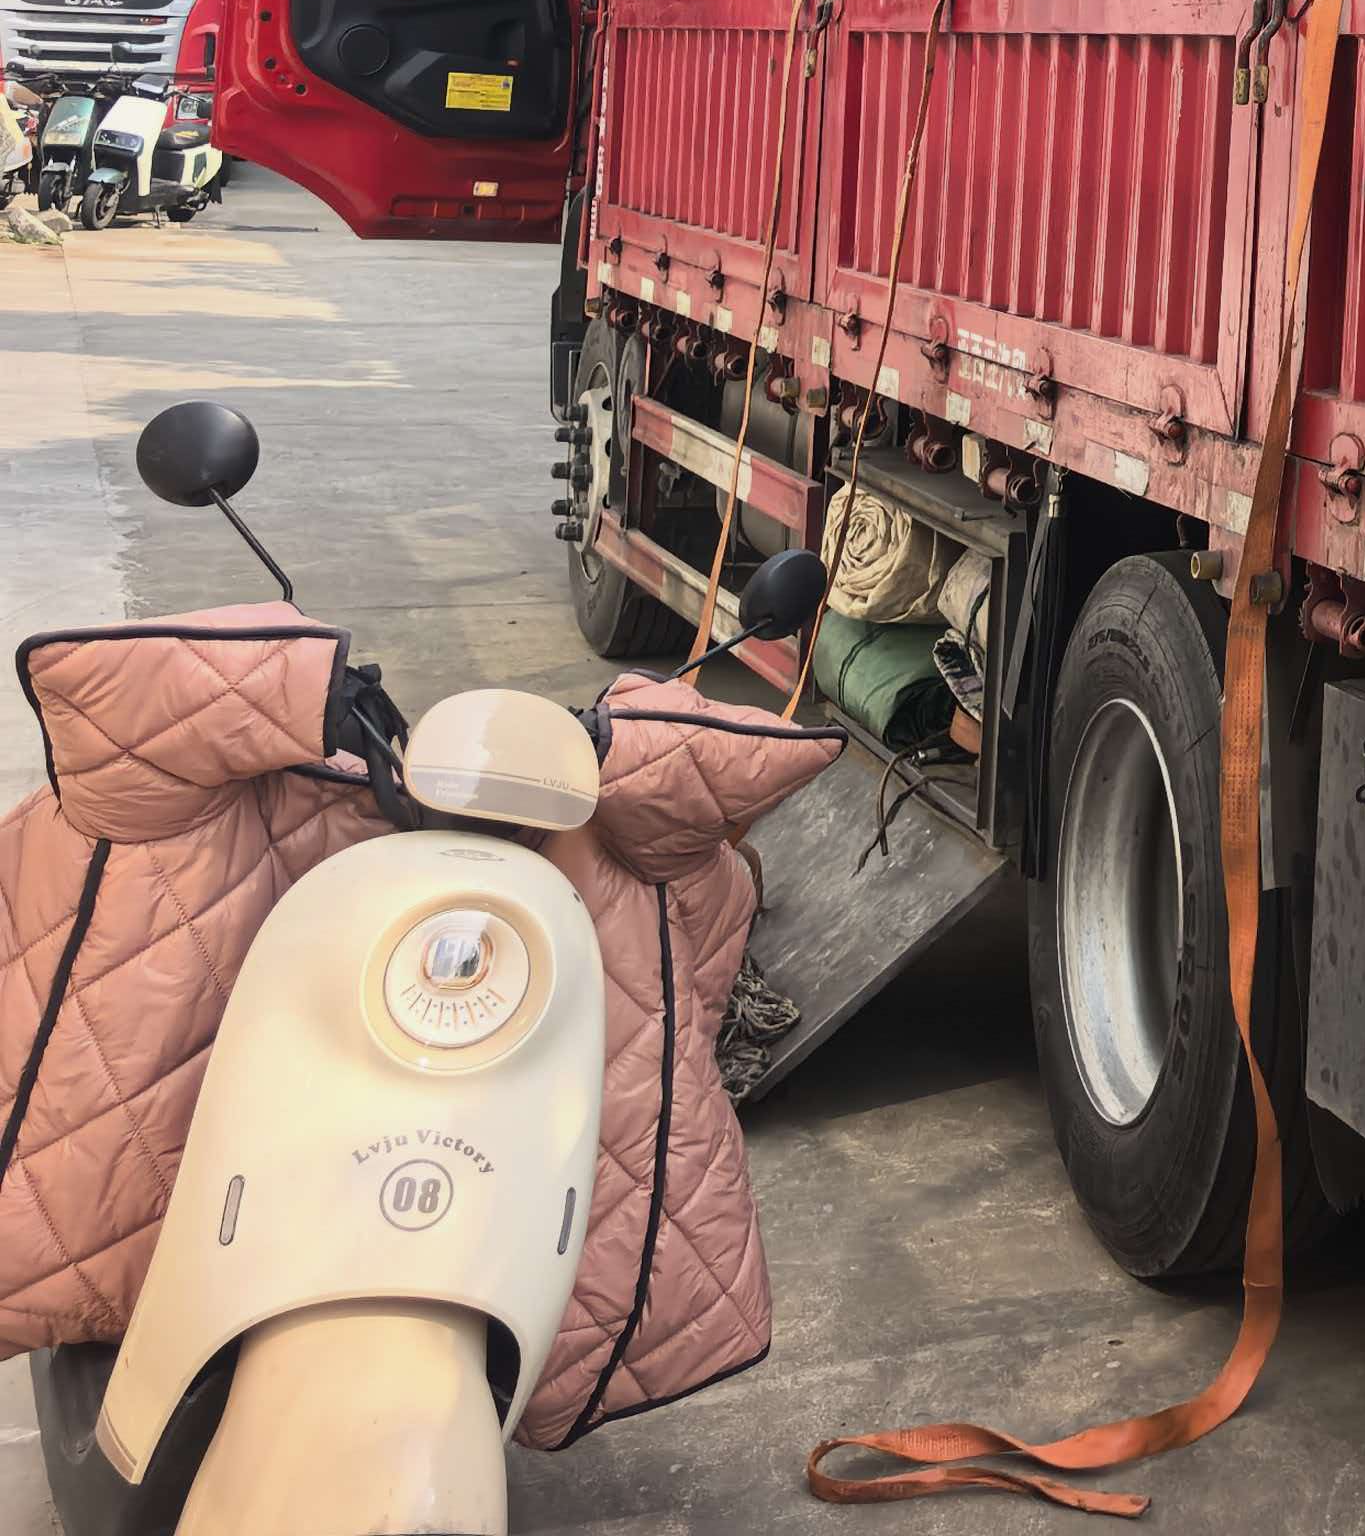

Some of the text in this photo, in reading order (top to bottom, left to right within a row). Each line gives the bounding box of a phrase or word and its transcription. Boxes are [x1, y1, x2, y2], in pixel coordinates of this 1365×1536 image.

[352, 1129, 494, 1173] Lvju Victory
[393, 1177, 441, 1214] 08
